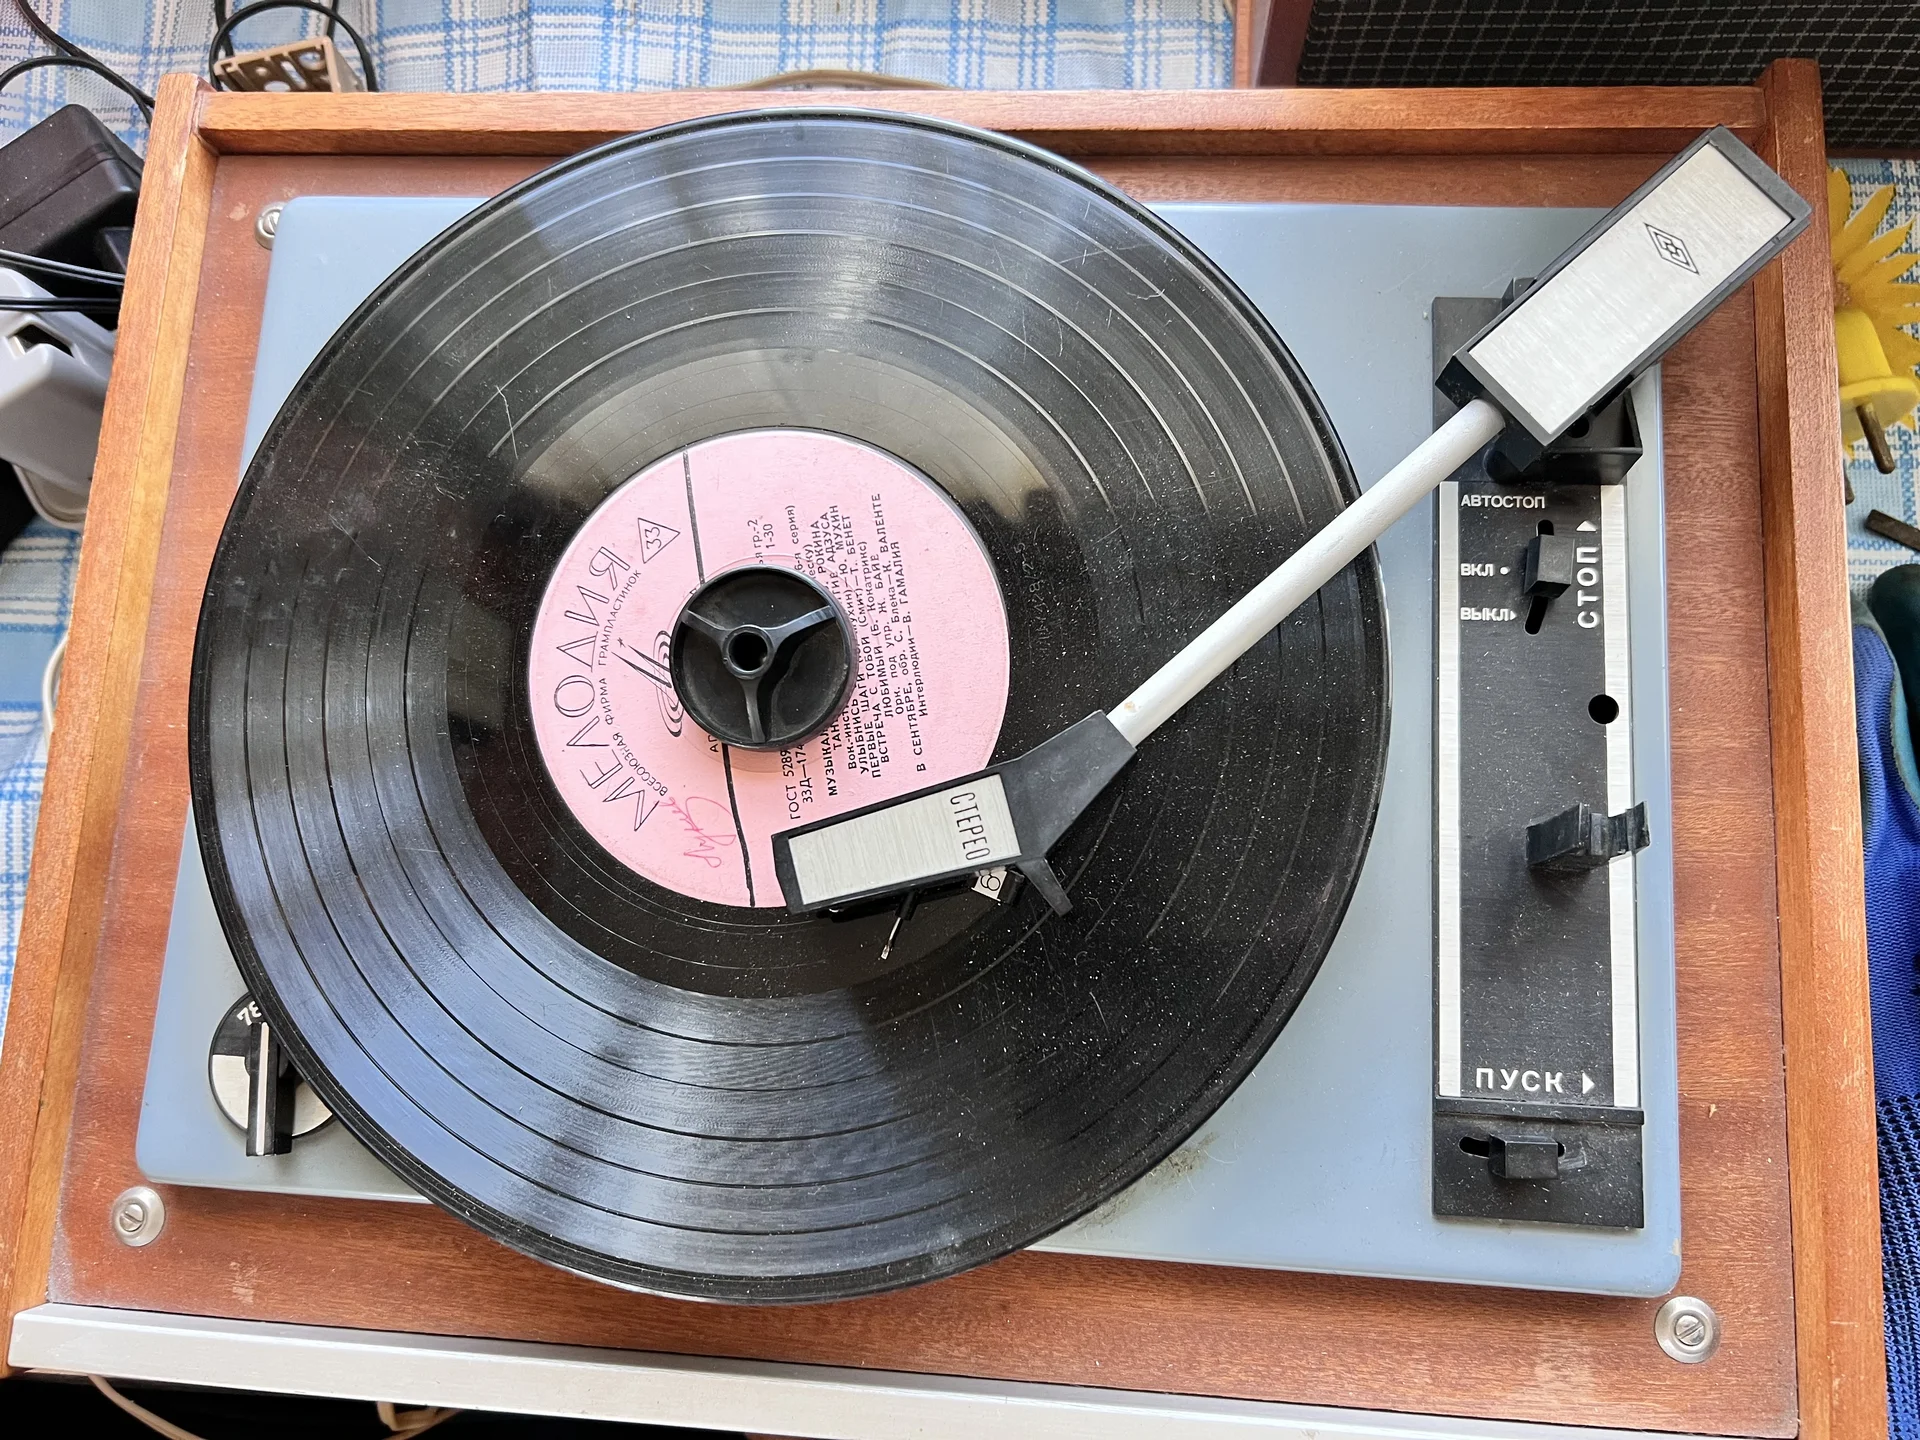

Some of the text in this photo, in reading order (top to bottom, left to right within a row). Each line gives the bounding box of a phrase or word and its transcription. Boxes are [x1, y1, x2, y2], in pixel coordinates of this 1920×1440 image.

[871, 493, 888, 552] ВАЛЕНТЕ
[1460, 494, 1546, 509] АВТОСТОП
[645, 526, 662, 550] 33
[762, 523, 775, 548] 1-30
[785, 505, 799, 544] серия)
[820, 512, 836, 562] АДЗУСА
[829, 505, 844, 550] МУХИН
[841, 515, 855, 555] БЕНЕТ
[890, 541, 908, 604] ГАМАЛИЯ
[1460, 563, 1494, 577] ВКЛ
[1576, 546, 1599, 629] СТОП
[877, 598, 887, 614] Ж.
[1460, 607, 1509, 621] ВЫКЛ
[802, 544, 842, 750] ТАН еску)
[810, 520, 856, 769] Вок.-инст РОКИНА
[857, 541, 893, 717] ЛЮБИМЫЙ (Б. Кокатрикс)
[883, 621, 894, 648] упр.
[893, 630, 903, 642] С.
[861, 636, 875, 679] ТОБОЙ
[888, 655, 898, 678] под
[898, 649, 908, 675] обр.
[553, 545, 660, 832] МЕЛОДИЯ
[598, 569, 669, 797] ВСЕСОЮЗНАЯ ФИРМА ГРАМПЛАСТИНОК
[855, 673, 869, 712] ШАГИ
[869, 686, 878, 695] С
[894, 686, 904, 714] Орк.
[848, 699, 869, 774] УЛЫБНИСЬ
[872, 703, 889, 763] ВСТРЕЧА
[903, 682, 922, 755] СЕНТЯБРЕ,
[818, 729, 837, 796] МУЗЫКАЛ
[864, 721, 881, 778] ПЕРВЫЕ
[916, 763, 926, 771] В
[779, 748, 800, 819] ГОСТ 5289
[950, 792, 991, 861] СТЕРЕО
[1475, 1067, 1564, 1093] ПУСК
